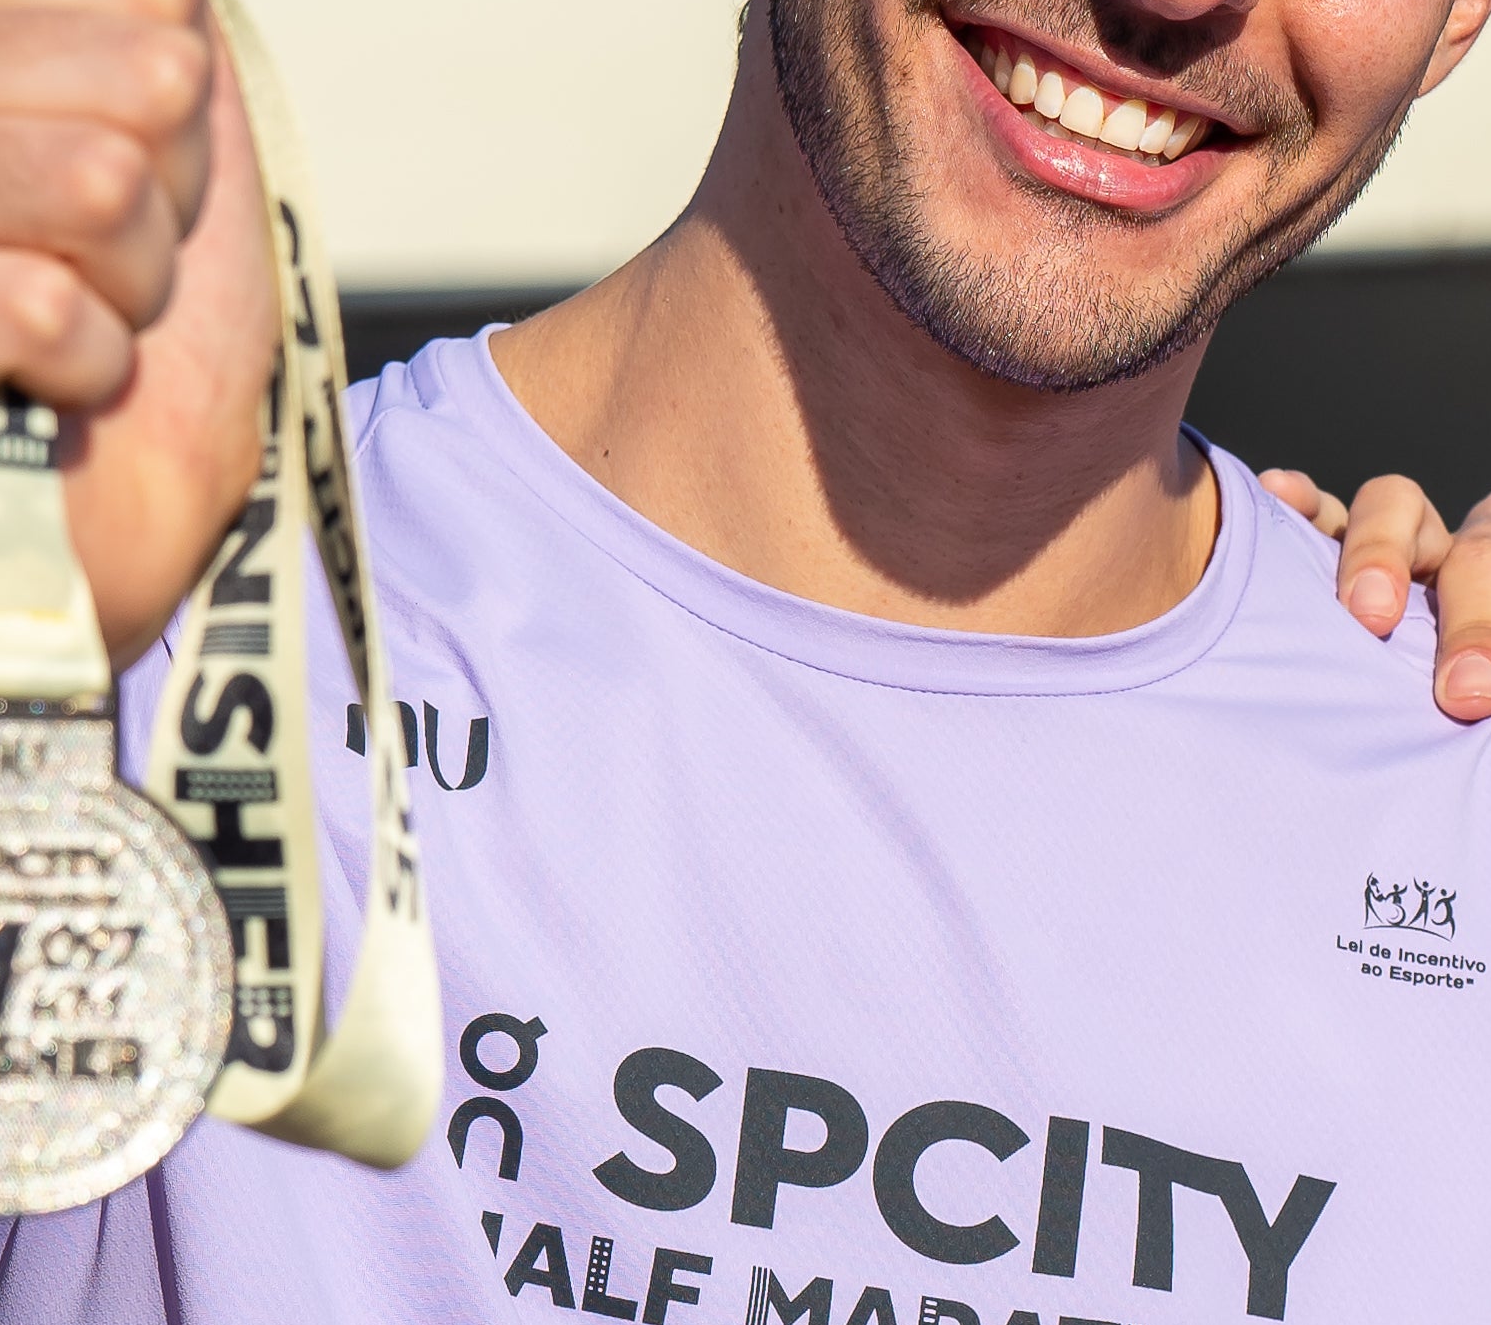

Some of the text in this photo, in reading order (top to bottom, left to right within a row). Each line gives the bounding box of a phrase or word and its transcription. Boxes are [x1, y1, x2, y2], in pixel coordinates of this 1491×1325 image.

[1336, 935, 1486, 973] Lei de Incentivo
[1361, 963, 1382, 977] ao
[591, 1046, 1338, 1322] SPCITY
